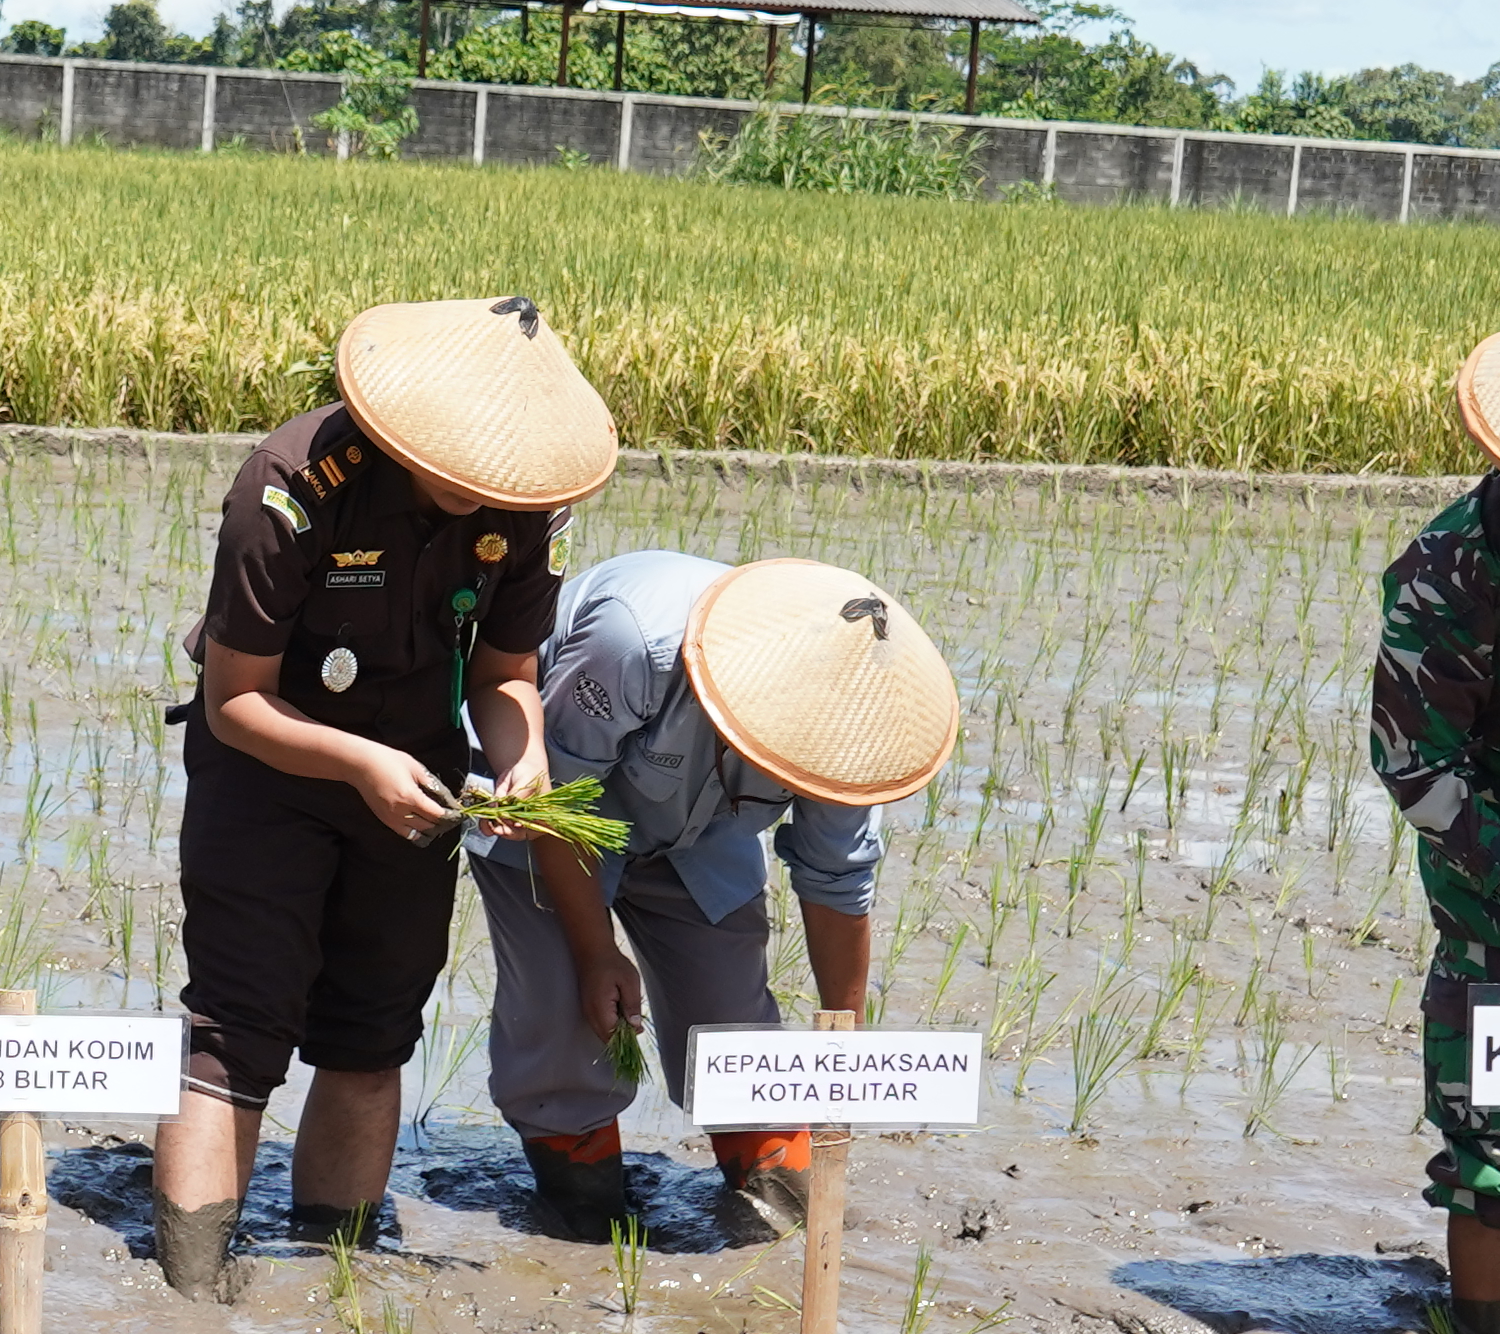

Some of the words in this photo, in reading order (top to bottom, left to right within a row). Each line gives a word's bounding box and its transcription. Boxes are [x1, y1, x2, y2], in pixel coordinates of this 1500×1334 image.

[68, 1040, 155, 1061] KODIM
[707, 1054, 806, 1074] KEPALA
[814, 1053, 968, 1073] KEJAKSAAN
[14, 1069, 109, 1090] BLITAR
[751, 1083, 820, 1102] KOTA
[828, 1082, 918, 1102] BLITAR
